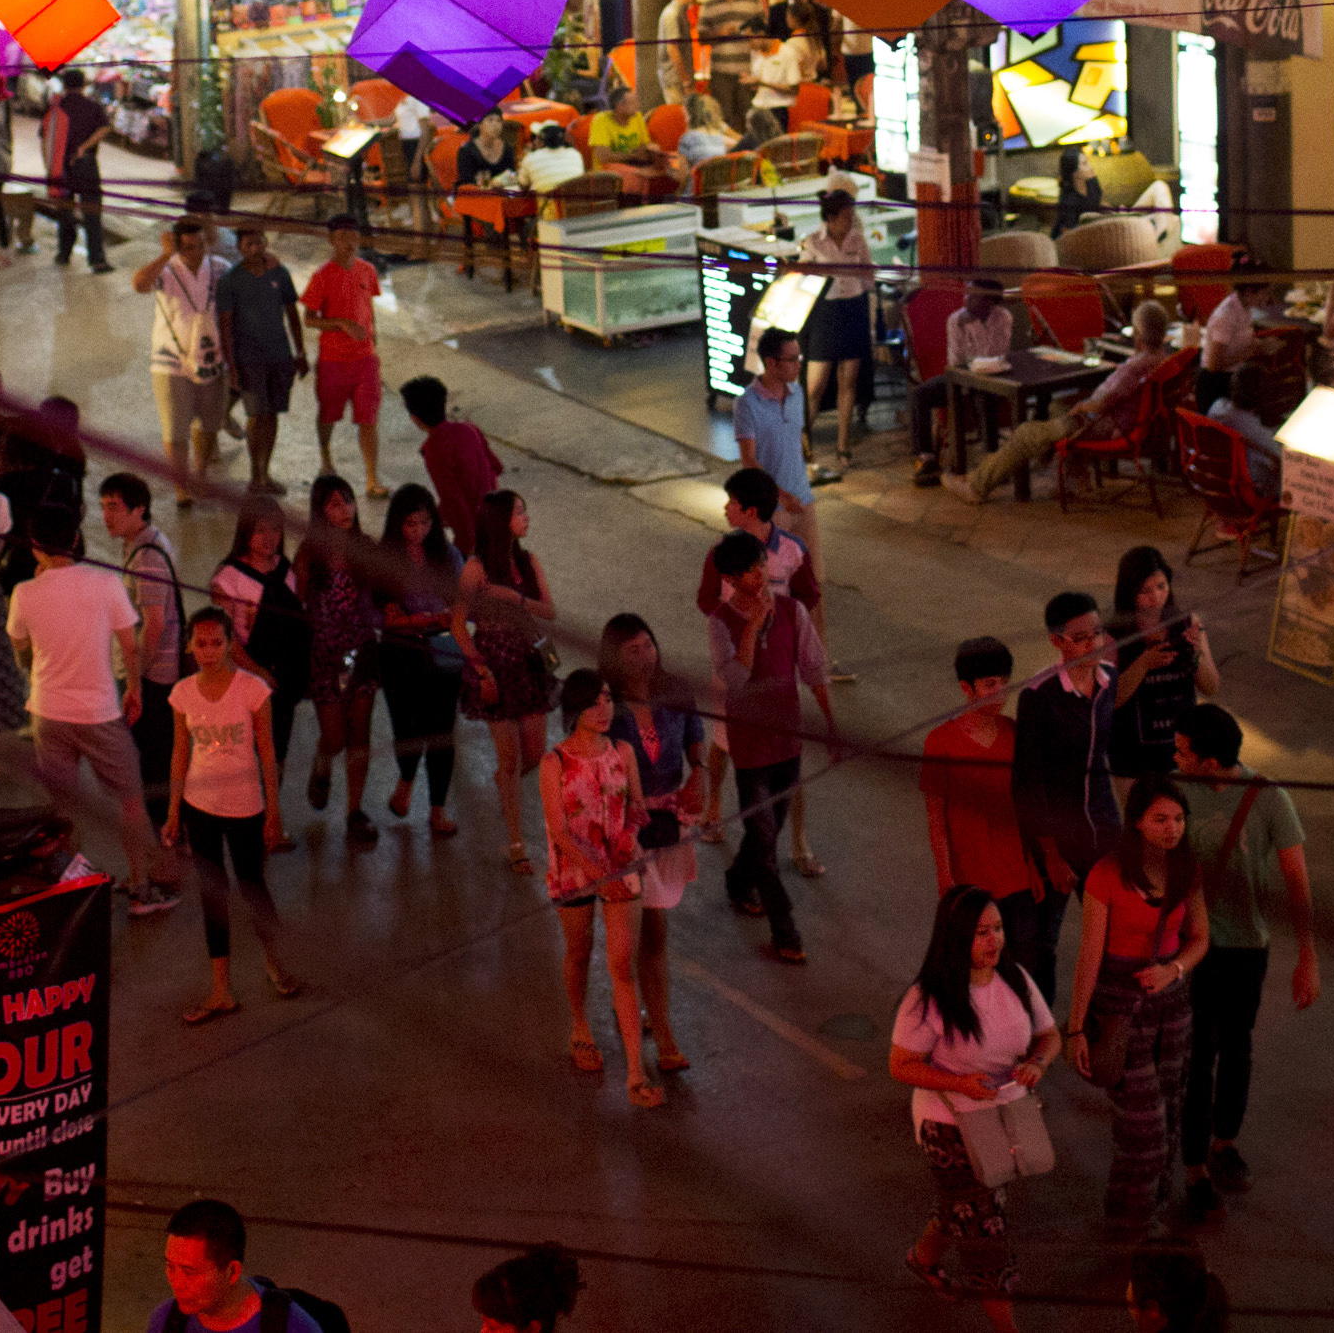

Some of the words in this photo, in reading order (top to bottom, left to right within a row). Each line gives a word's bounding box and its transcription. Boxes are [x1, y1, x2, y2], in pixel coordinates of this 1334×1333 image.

[3, 973, 95, 1024] HAPPY
[54, 1082, 93, 1116] DAY
[52, 1115, 95, 1145] close
[44, 1163, 96, 1197] Buy
[7, 1205, 94, 1254] drinks
[49, 1245, 93, 1291] get
